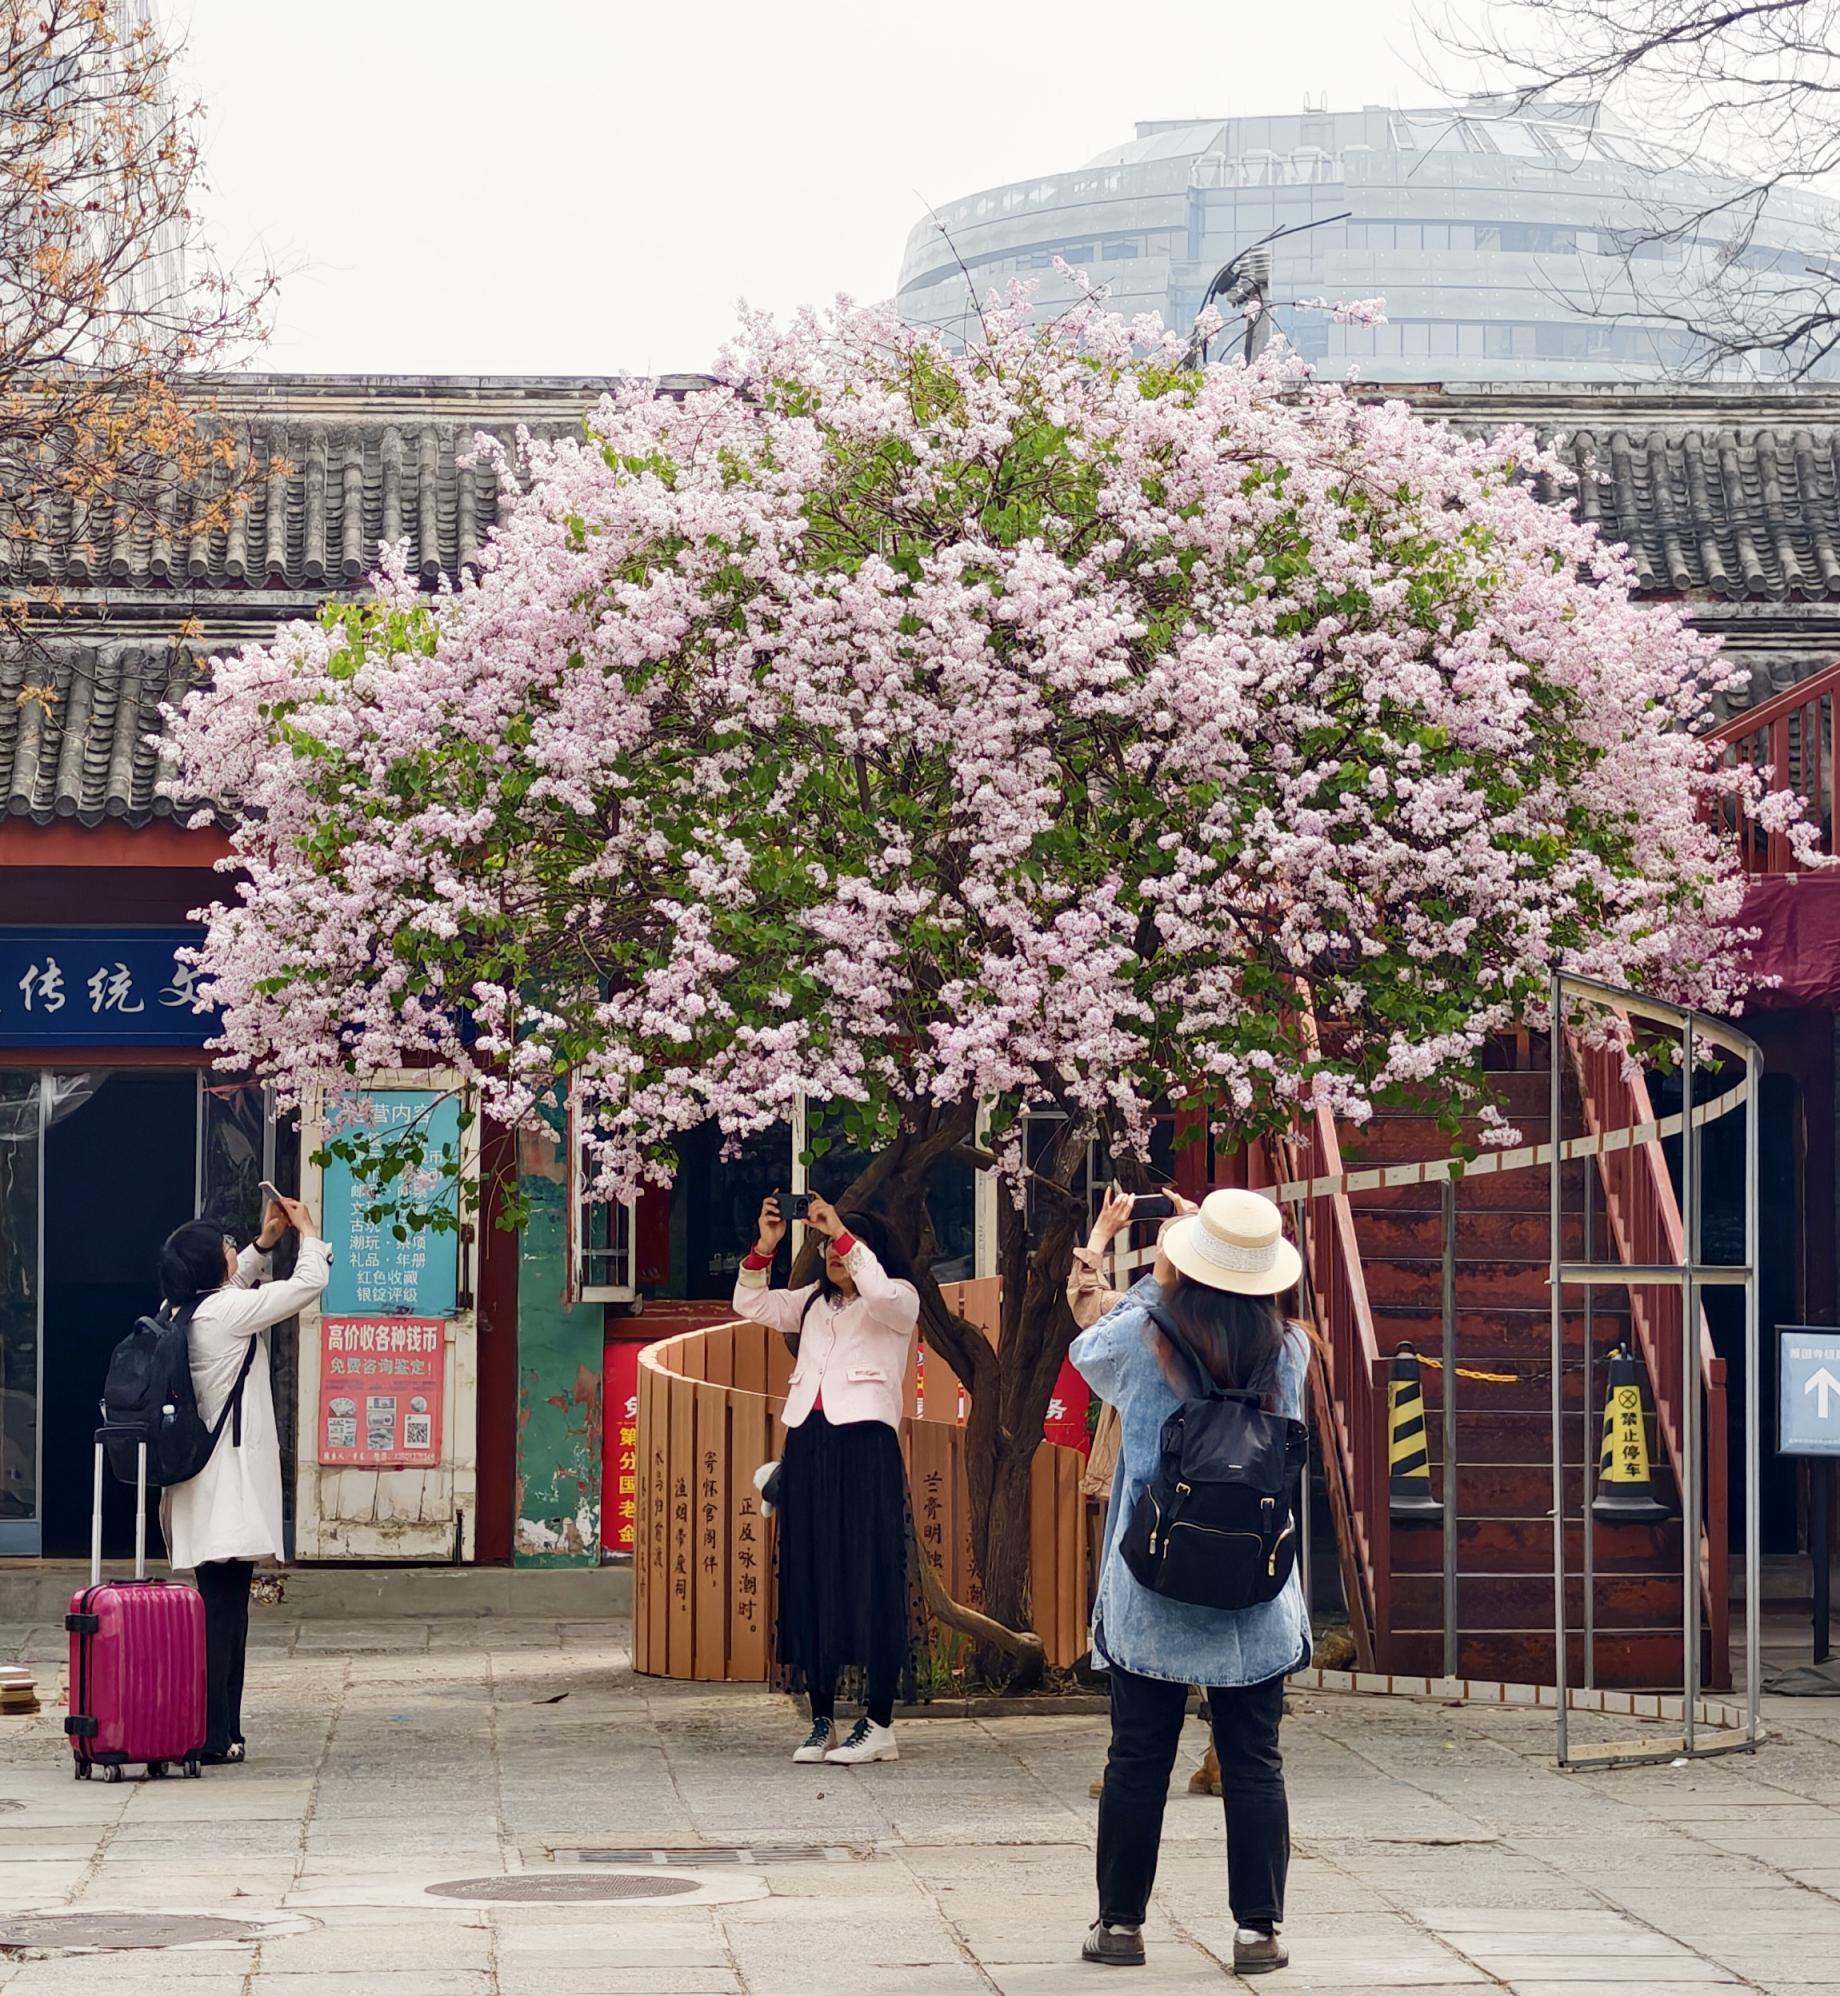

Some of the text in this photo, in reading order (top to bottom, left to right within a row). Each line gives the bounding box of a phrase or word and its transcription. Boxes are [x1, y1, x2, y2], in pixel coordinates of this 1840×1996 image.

[356, 1269, 418, 1285] 红色收藏
[356, 1287, 418, 1303] 银锭评级
[328, 1324, 438, 1352] 高价收各种钱币
[1620, 1412, 1641, 1477] 禁止停车
